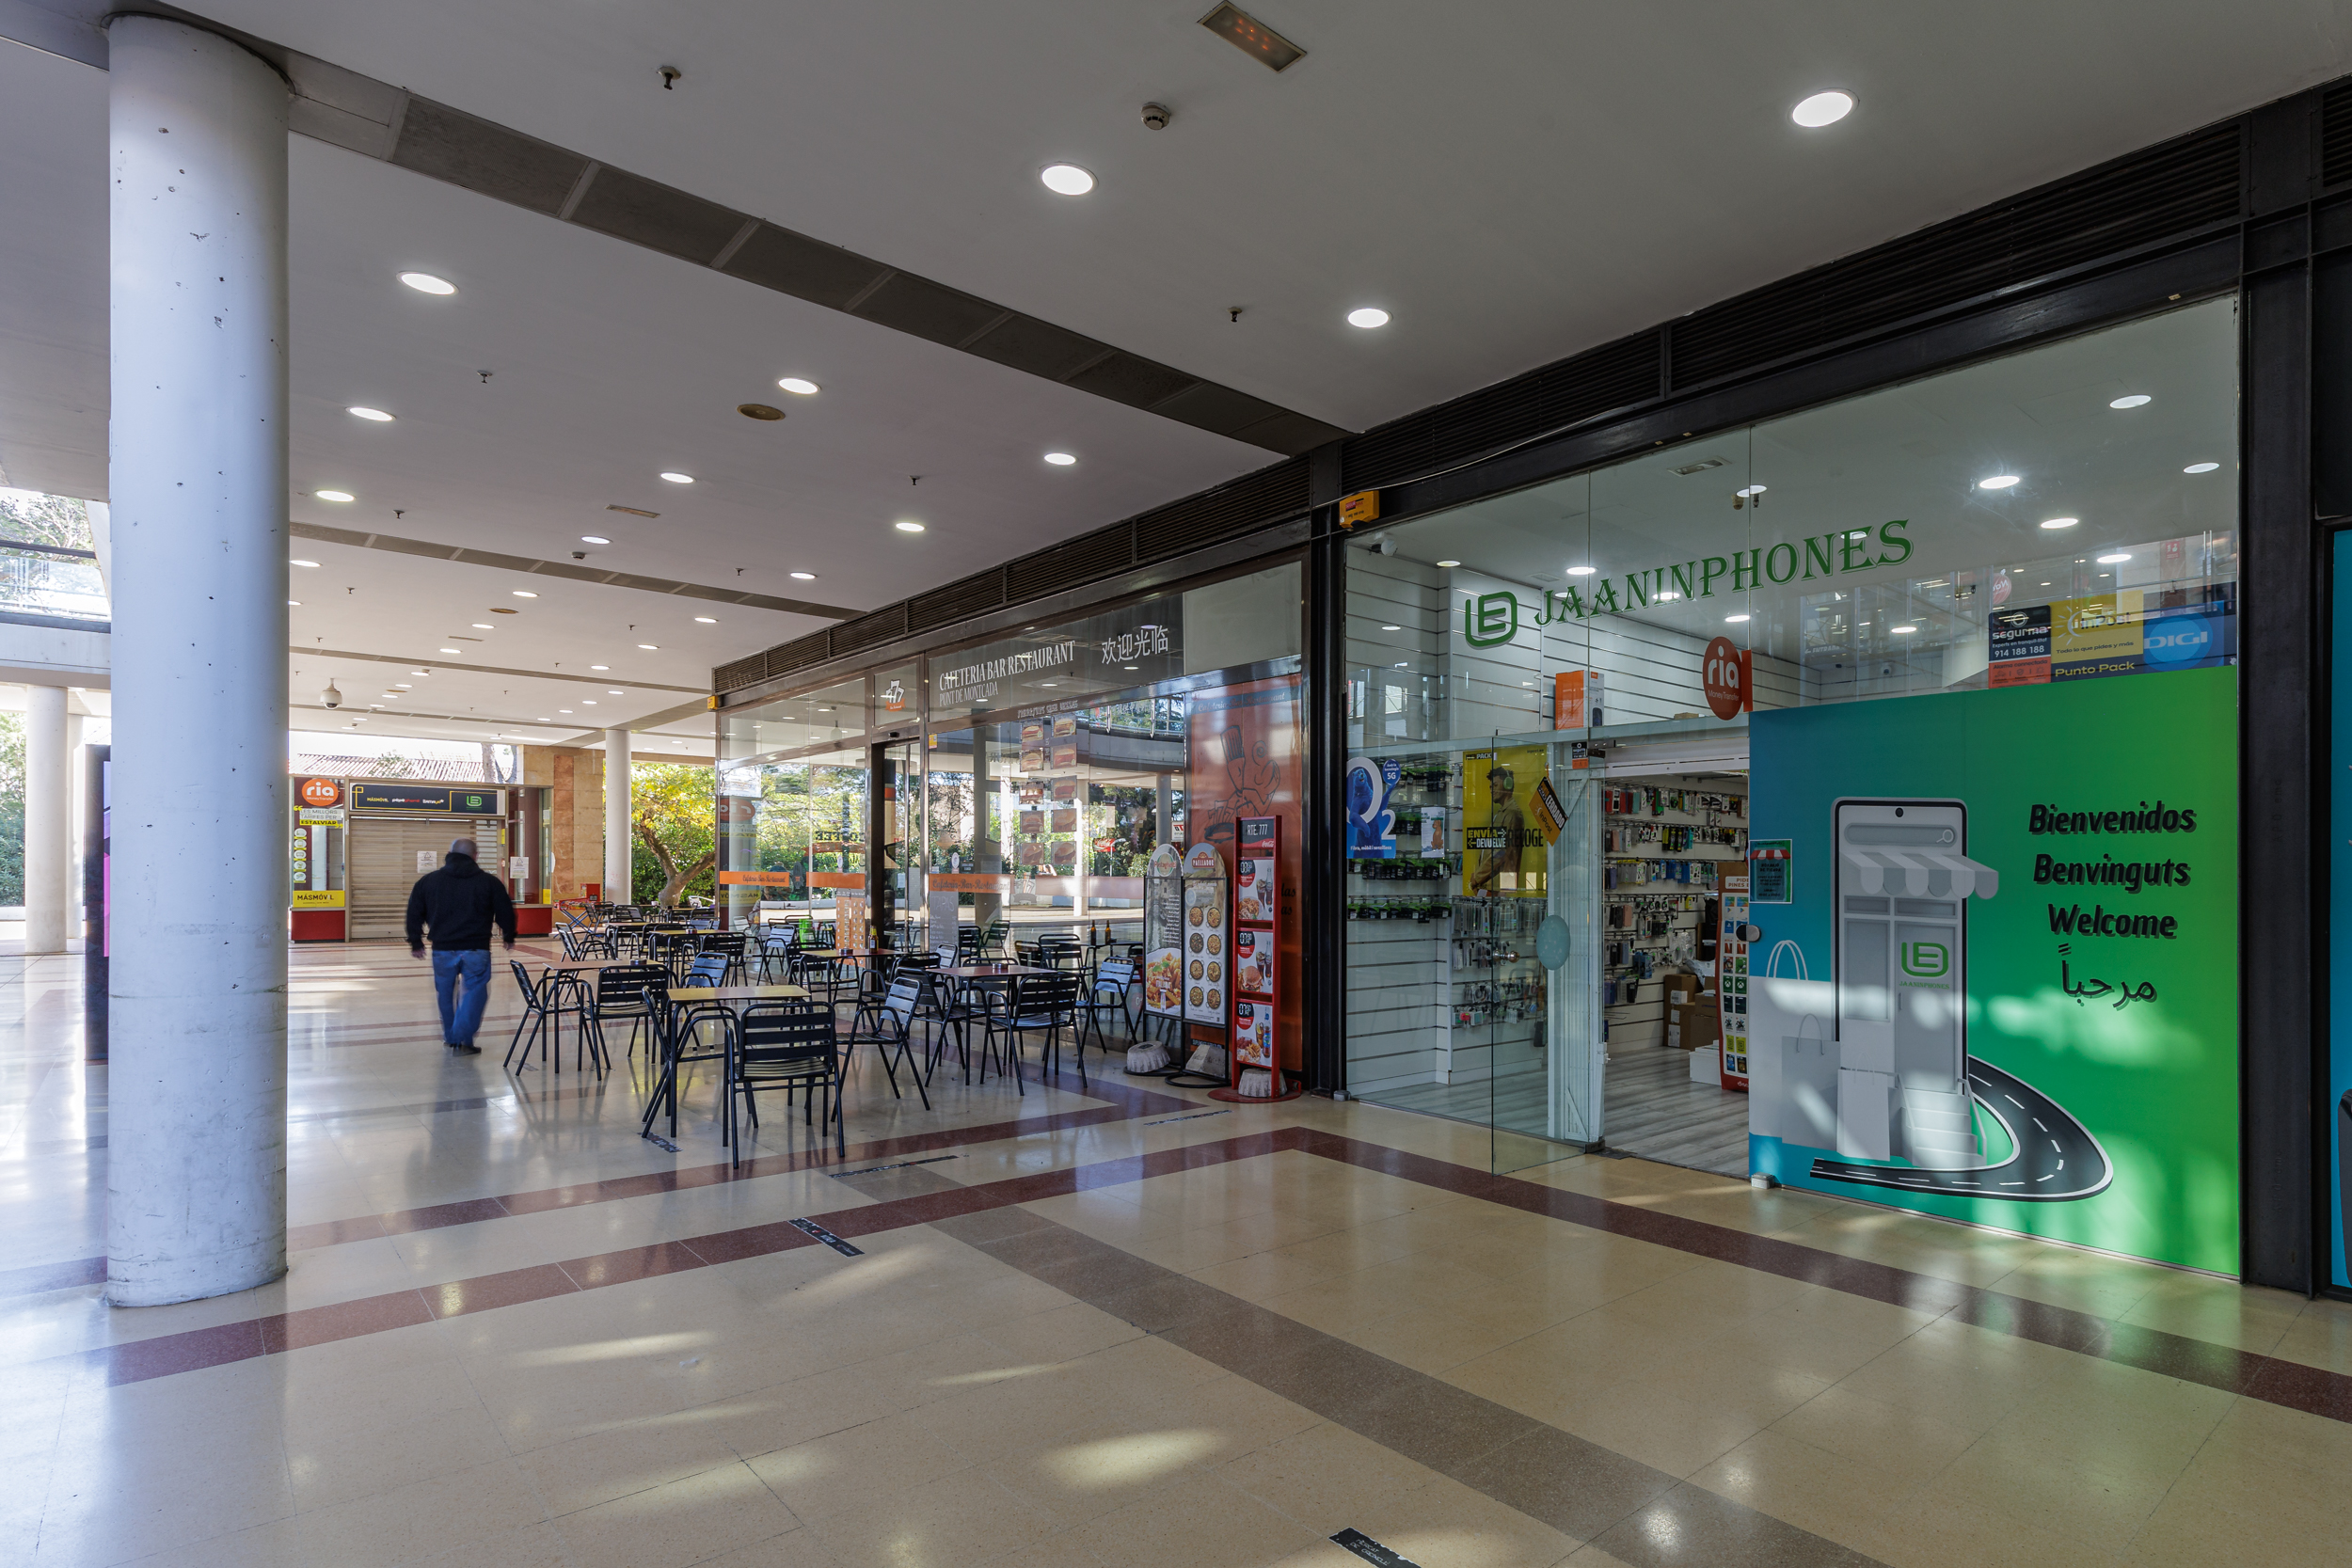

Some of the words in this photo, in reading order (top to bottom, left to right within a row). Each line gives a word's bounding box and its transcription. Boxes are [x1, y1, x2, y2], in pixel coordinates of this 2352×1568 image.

[1534, 518, 1915, 627] JAANINPHONES
[1101, 625, 1168, 665] 欢迎光临
[1992, 626, 2049, 641] segurma
[2143, 631, 2208, 649] DIGI
[1994, 649, 2010, 657] 914
[2011, 647, 2026, 656] 188
[2029, 644, 2044, 654] 188
[939, 666, 985, 691] CAFETERIA
[987, 658, 1006, 680] BAR
[1008, 640, 1076, 675] RESTAURANT
[1708, 645, 1740, 689] ria
[2055, 665, 2096, 677] Punto
[2098, 660, 2136, 673] Pack
[939, 689, 954, 707] PUNT
[955, 689, 963, 703] DE
[963, 680, 999, 702] MONTCADA
[306, 782, 334, 796] ria
[1545, 794, 1566, 829] CERRADO
[2028, 800, 2197, 835] Bienvenidos
[1259, 823, 1268, 835] 777
[1468, 828, 1498, 838] ENVÍA
[1476, 837, 1506, 848] DEVUELVE
[1507, 828, 1544, 847] RECOGE
[2033, 853, 2191, 894] Benvinguts
[2047, 903, 2178, 939] Welcome
[1899, 980, 1950, 990] JAANINPHONES
